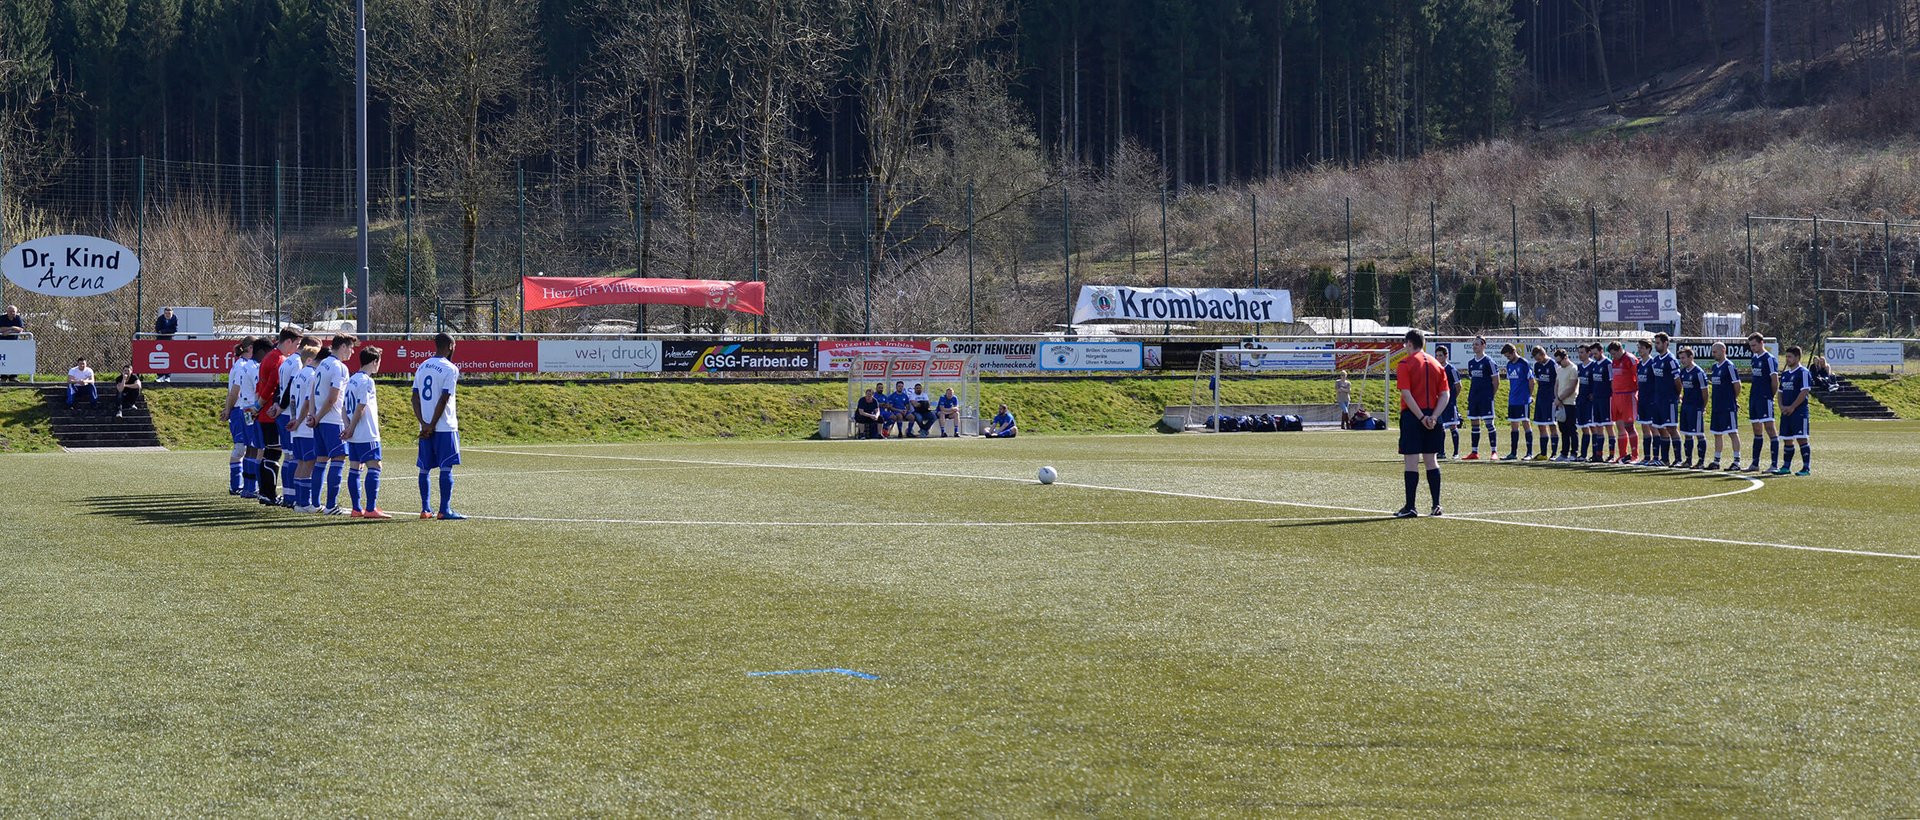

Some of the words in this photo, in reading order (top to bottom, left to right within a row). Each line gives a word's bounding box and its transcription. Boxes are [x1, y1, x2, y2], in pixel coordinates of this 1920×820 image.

[22, 248, 54, 268] Dr.
[66, 247, 120, 269] Kind
[37, 267, 104, 290] Arena
[543, 286, 597, 299] Herzlich
[600, 281, 687, 294] Willkommen!
[1118, 289, 1272, 321] Krombacher
[953, 343, 983, 354] SPORT
[984, 343, 1036, 355] HENNECKEN
[1827, 348, 1855, 360] OWG
[184, 352, 219, 369] Gut
[489, 361, 533, 369] Gemeinden
[704, 355, 808, 368] GSG-Farben.de
[422, 375, 433, 401] 8
